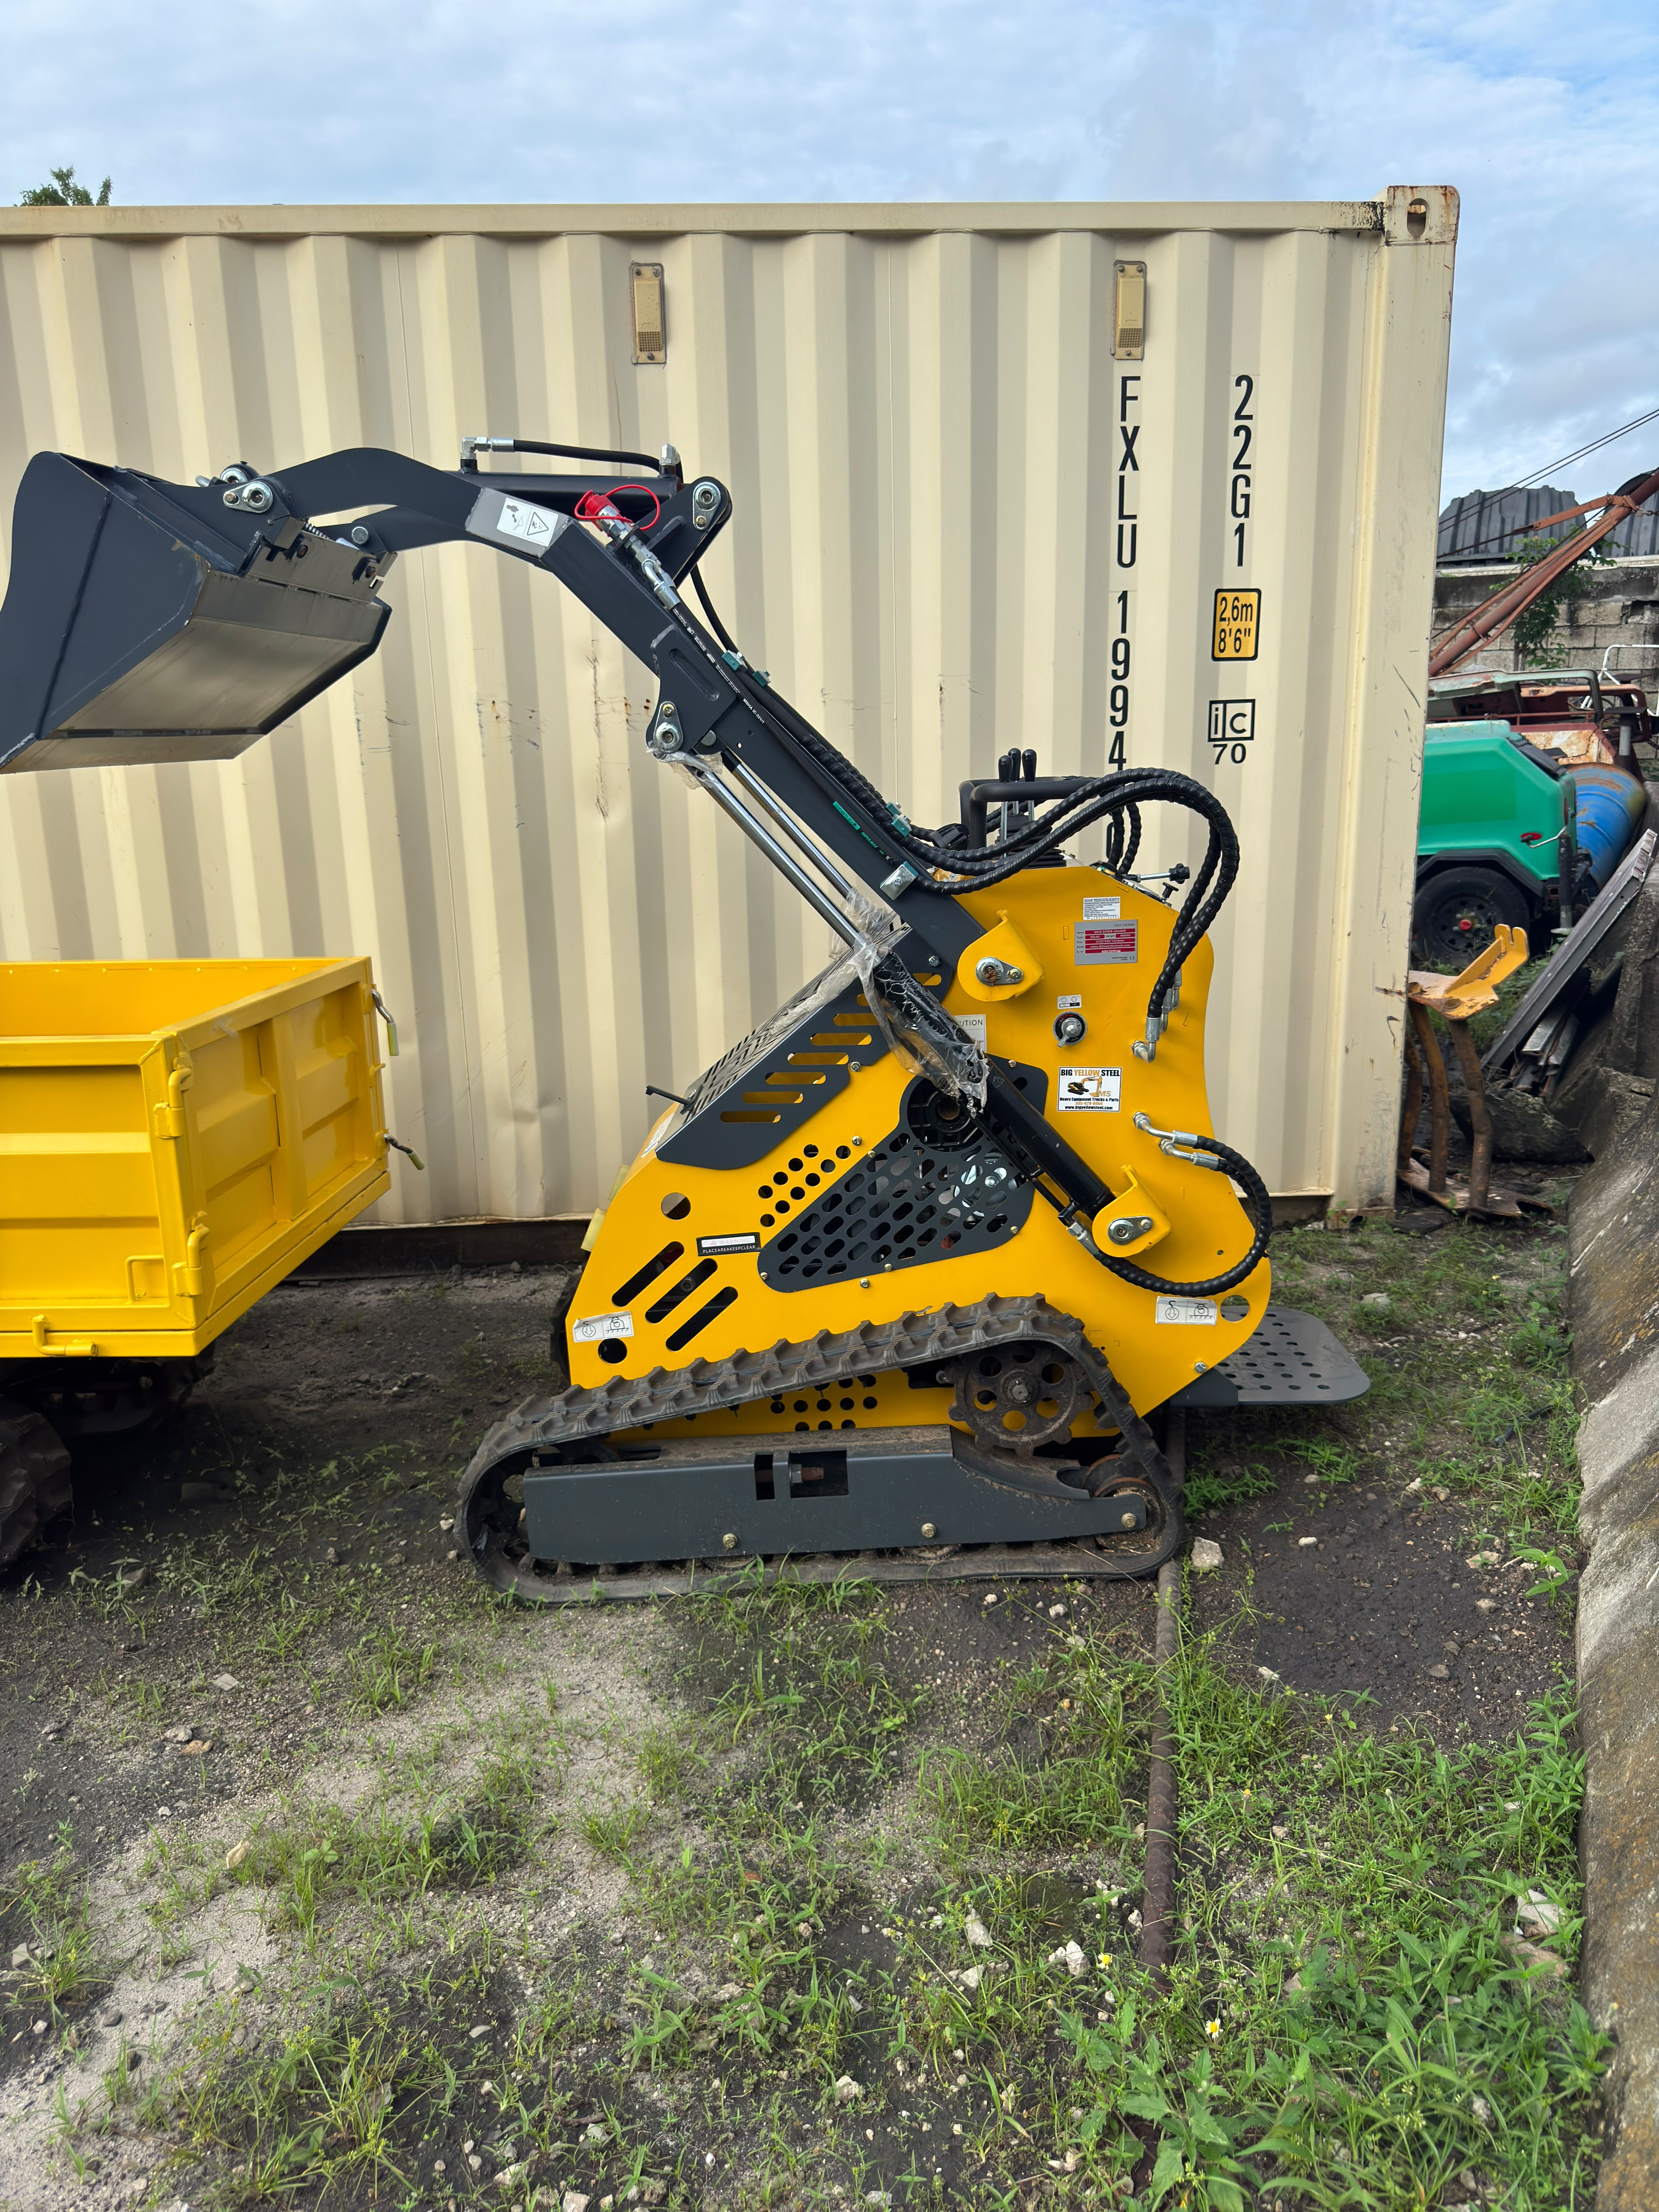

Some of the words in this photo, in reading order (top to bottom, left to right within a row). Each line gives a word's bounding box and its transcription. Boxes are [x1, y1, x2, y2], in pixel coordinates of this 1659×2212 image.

[1118, 376, 1141, 568] FXLU
[1232, 375, 1253, 566] 22G1
[1219, 597, 1253, 626] 2,6m
[743, 699, 753, 710] MSHA
[1213, 744, 1246, 764] 70
[703, 1245, 756, 1253] PLACEAREAKEEPCLEAR
